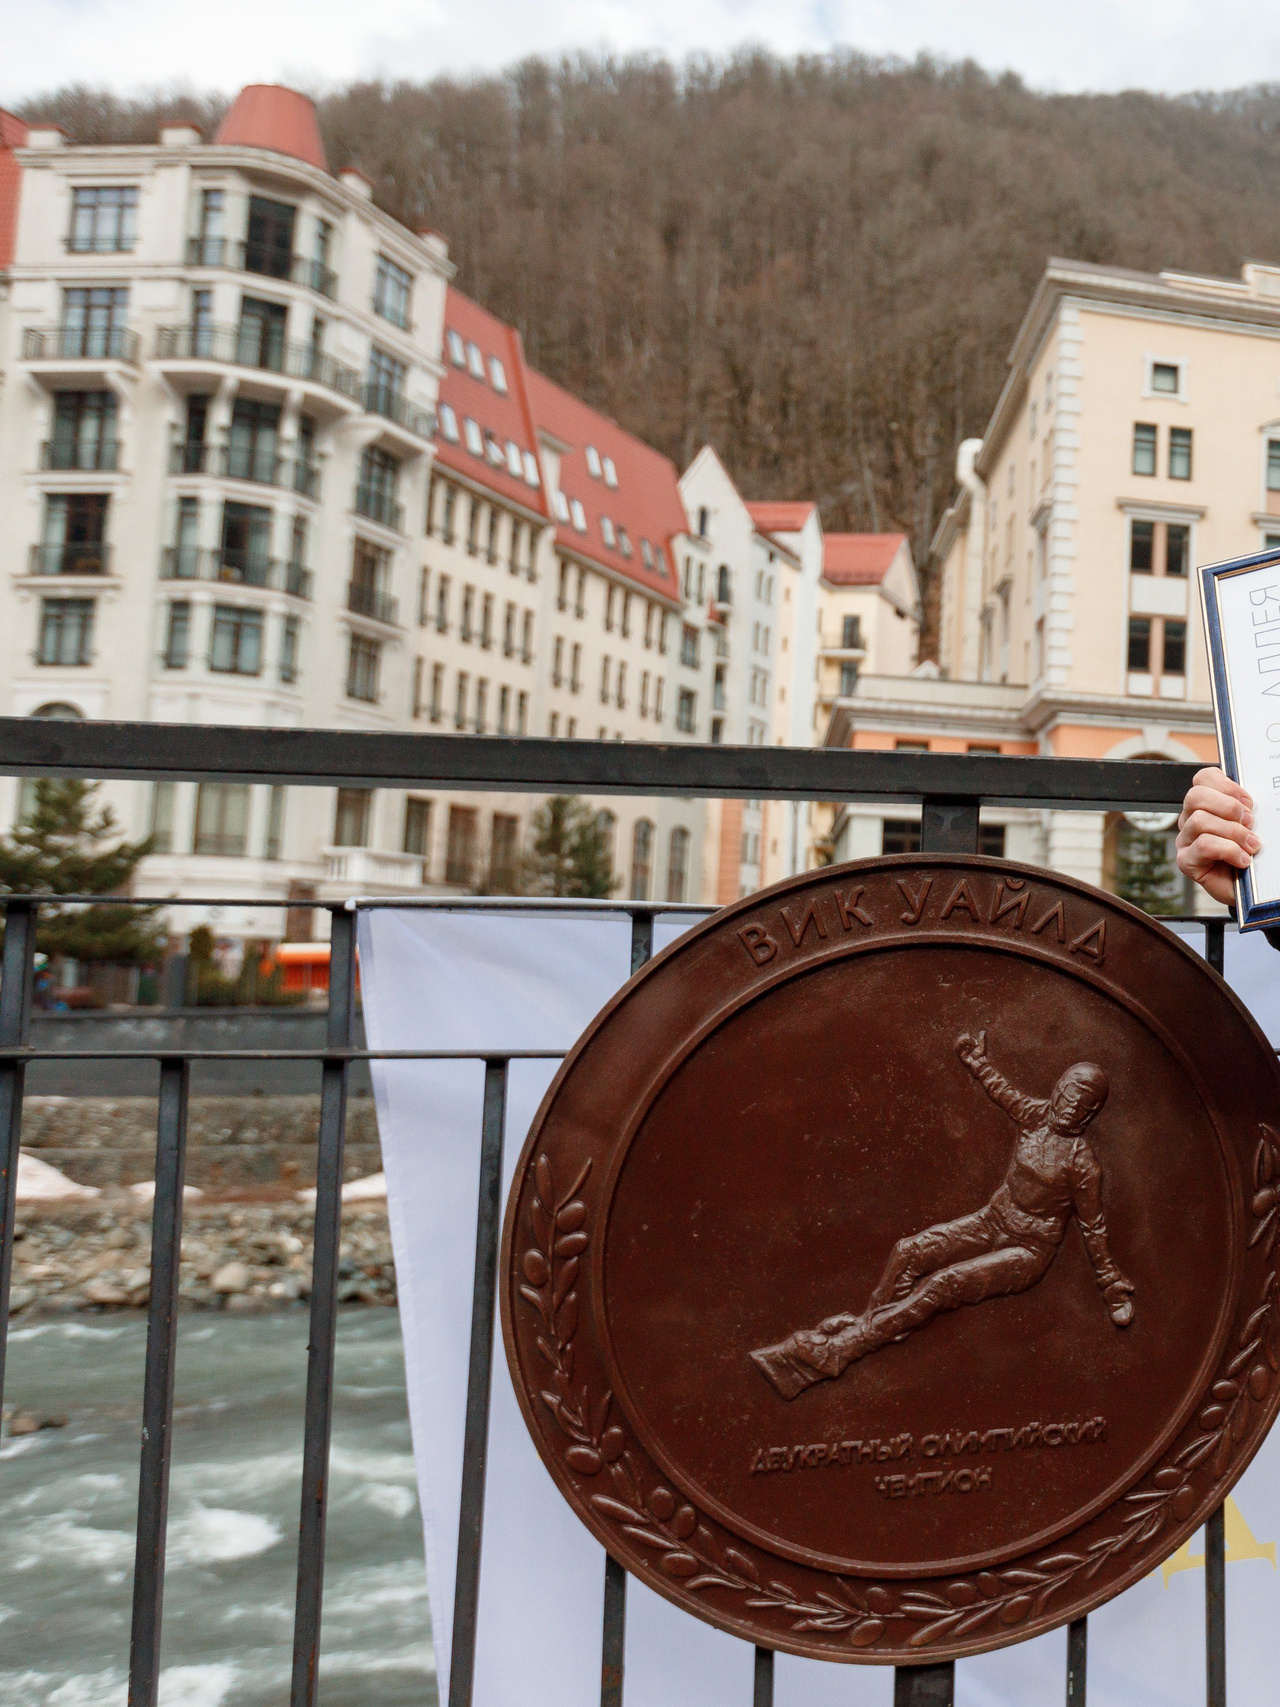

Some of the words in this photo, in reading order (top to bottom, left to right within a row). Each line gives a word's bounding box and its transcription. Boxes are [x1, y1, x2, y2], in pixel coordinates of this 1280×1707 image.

[738, 885, 874, 966] ВИК
[897, 878, 1107, 966] УАЙЛД
[750, 1432, 915, 1474] ДВУКРАТНЫЙ
[922, 1416, 1108, 1459] ОЛИМПИЙСКИЙ
[874, 1466, 993, 1500] ЧЕМПИОН
